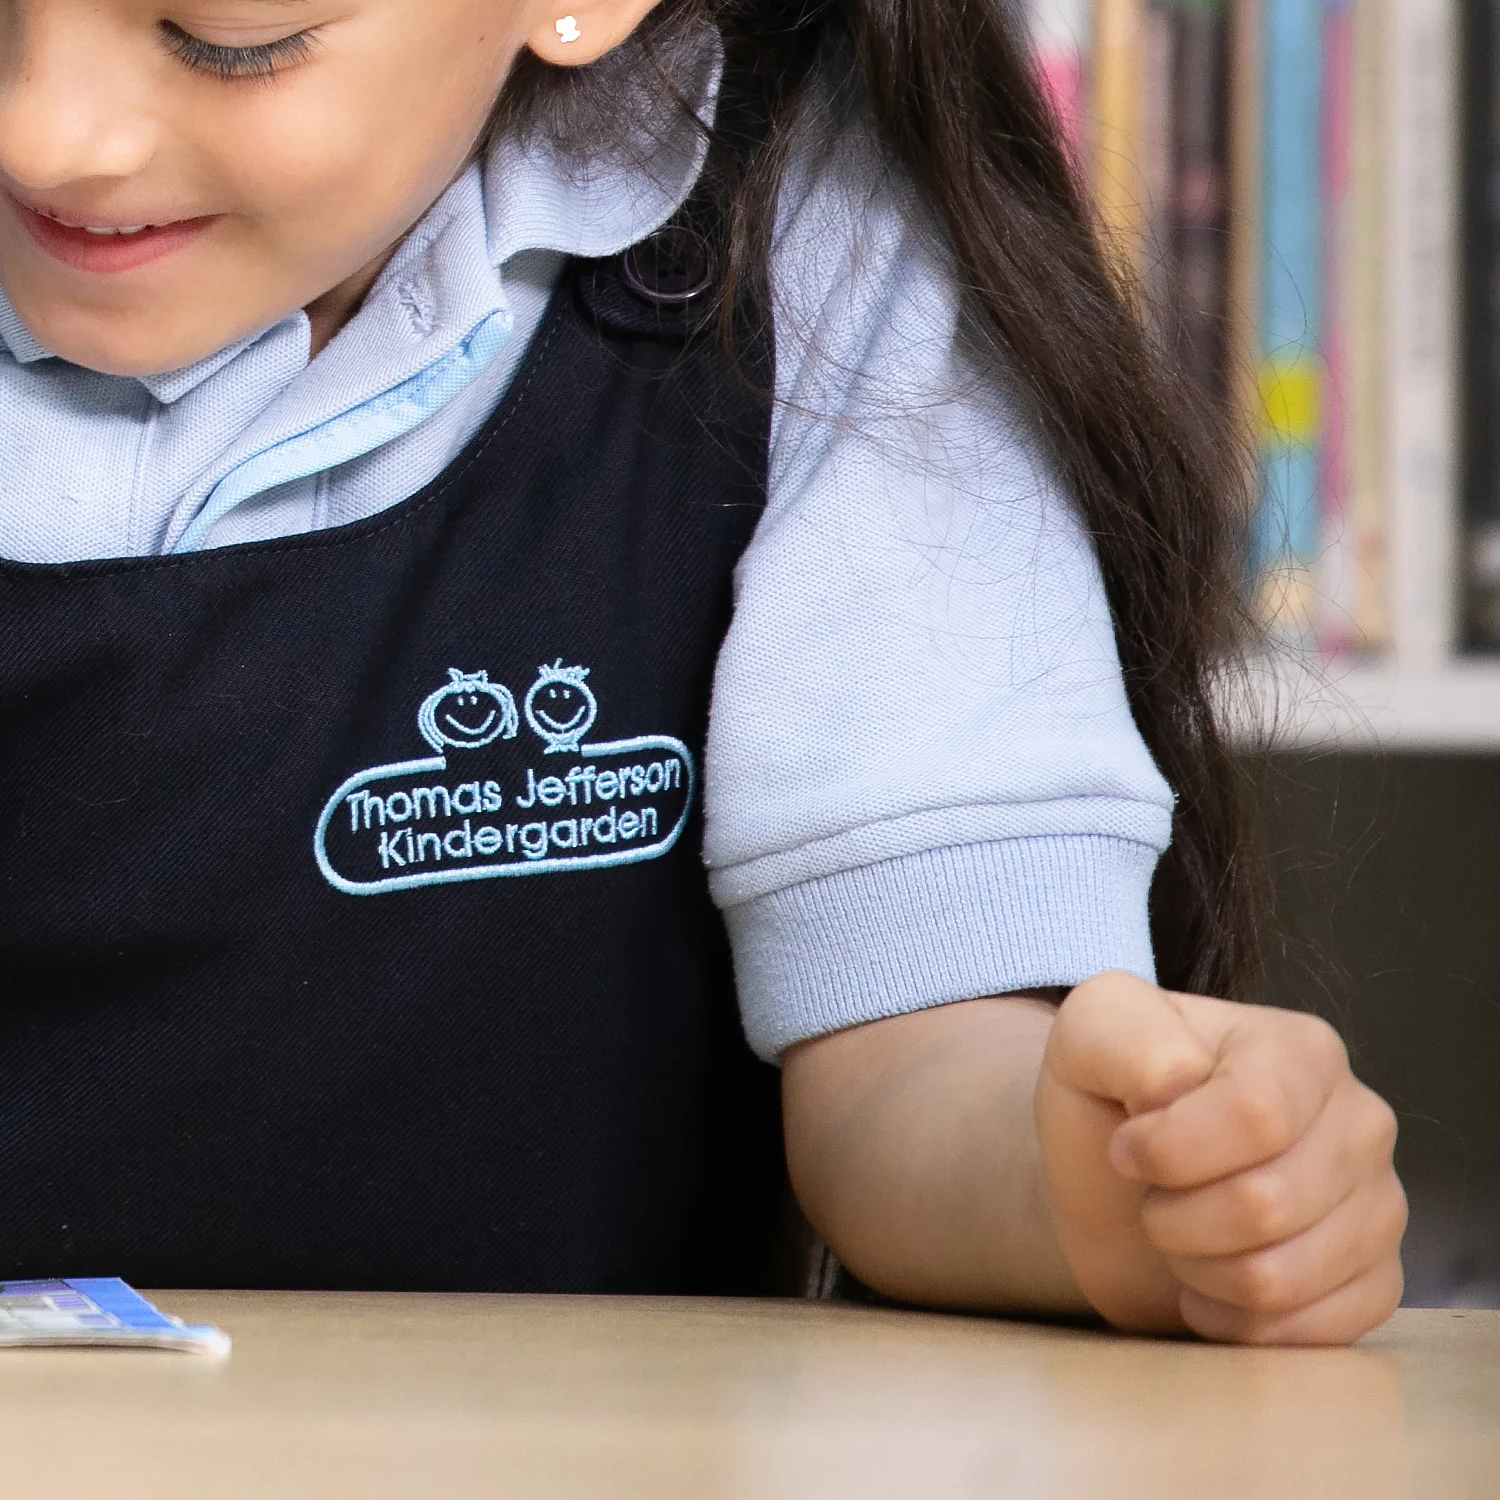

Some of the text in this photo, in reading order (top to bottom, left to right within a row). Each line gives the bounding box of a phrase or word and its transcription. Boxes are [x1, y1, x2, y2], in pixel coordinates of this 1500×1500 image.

[346, 758, 683, 834] Thomas Jefferson
[378, 806, 658, 869] Kindergarden
